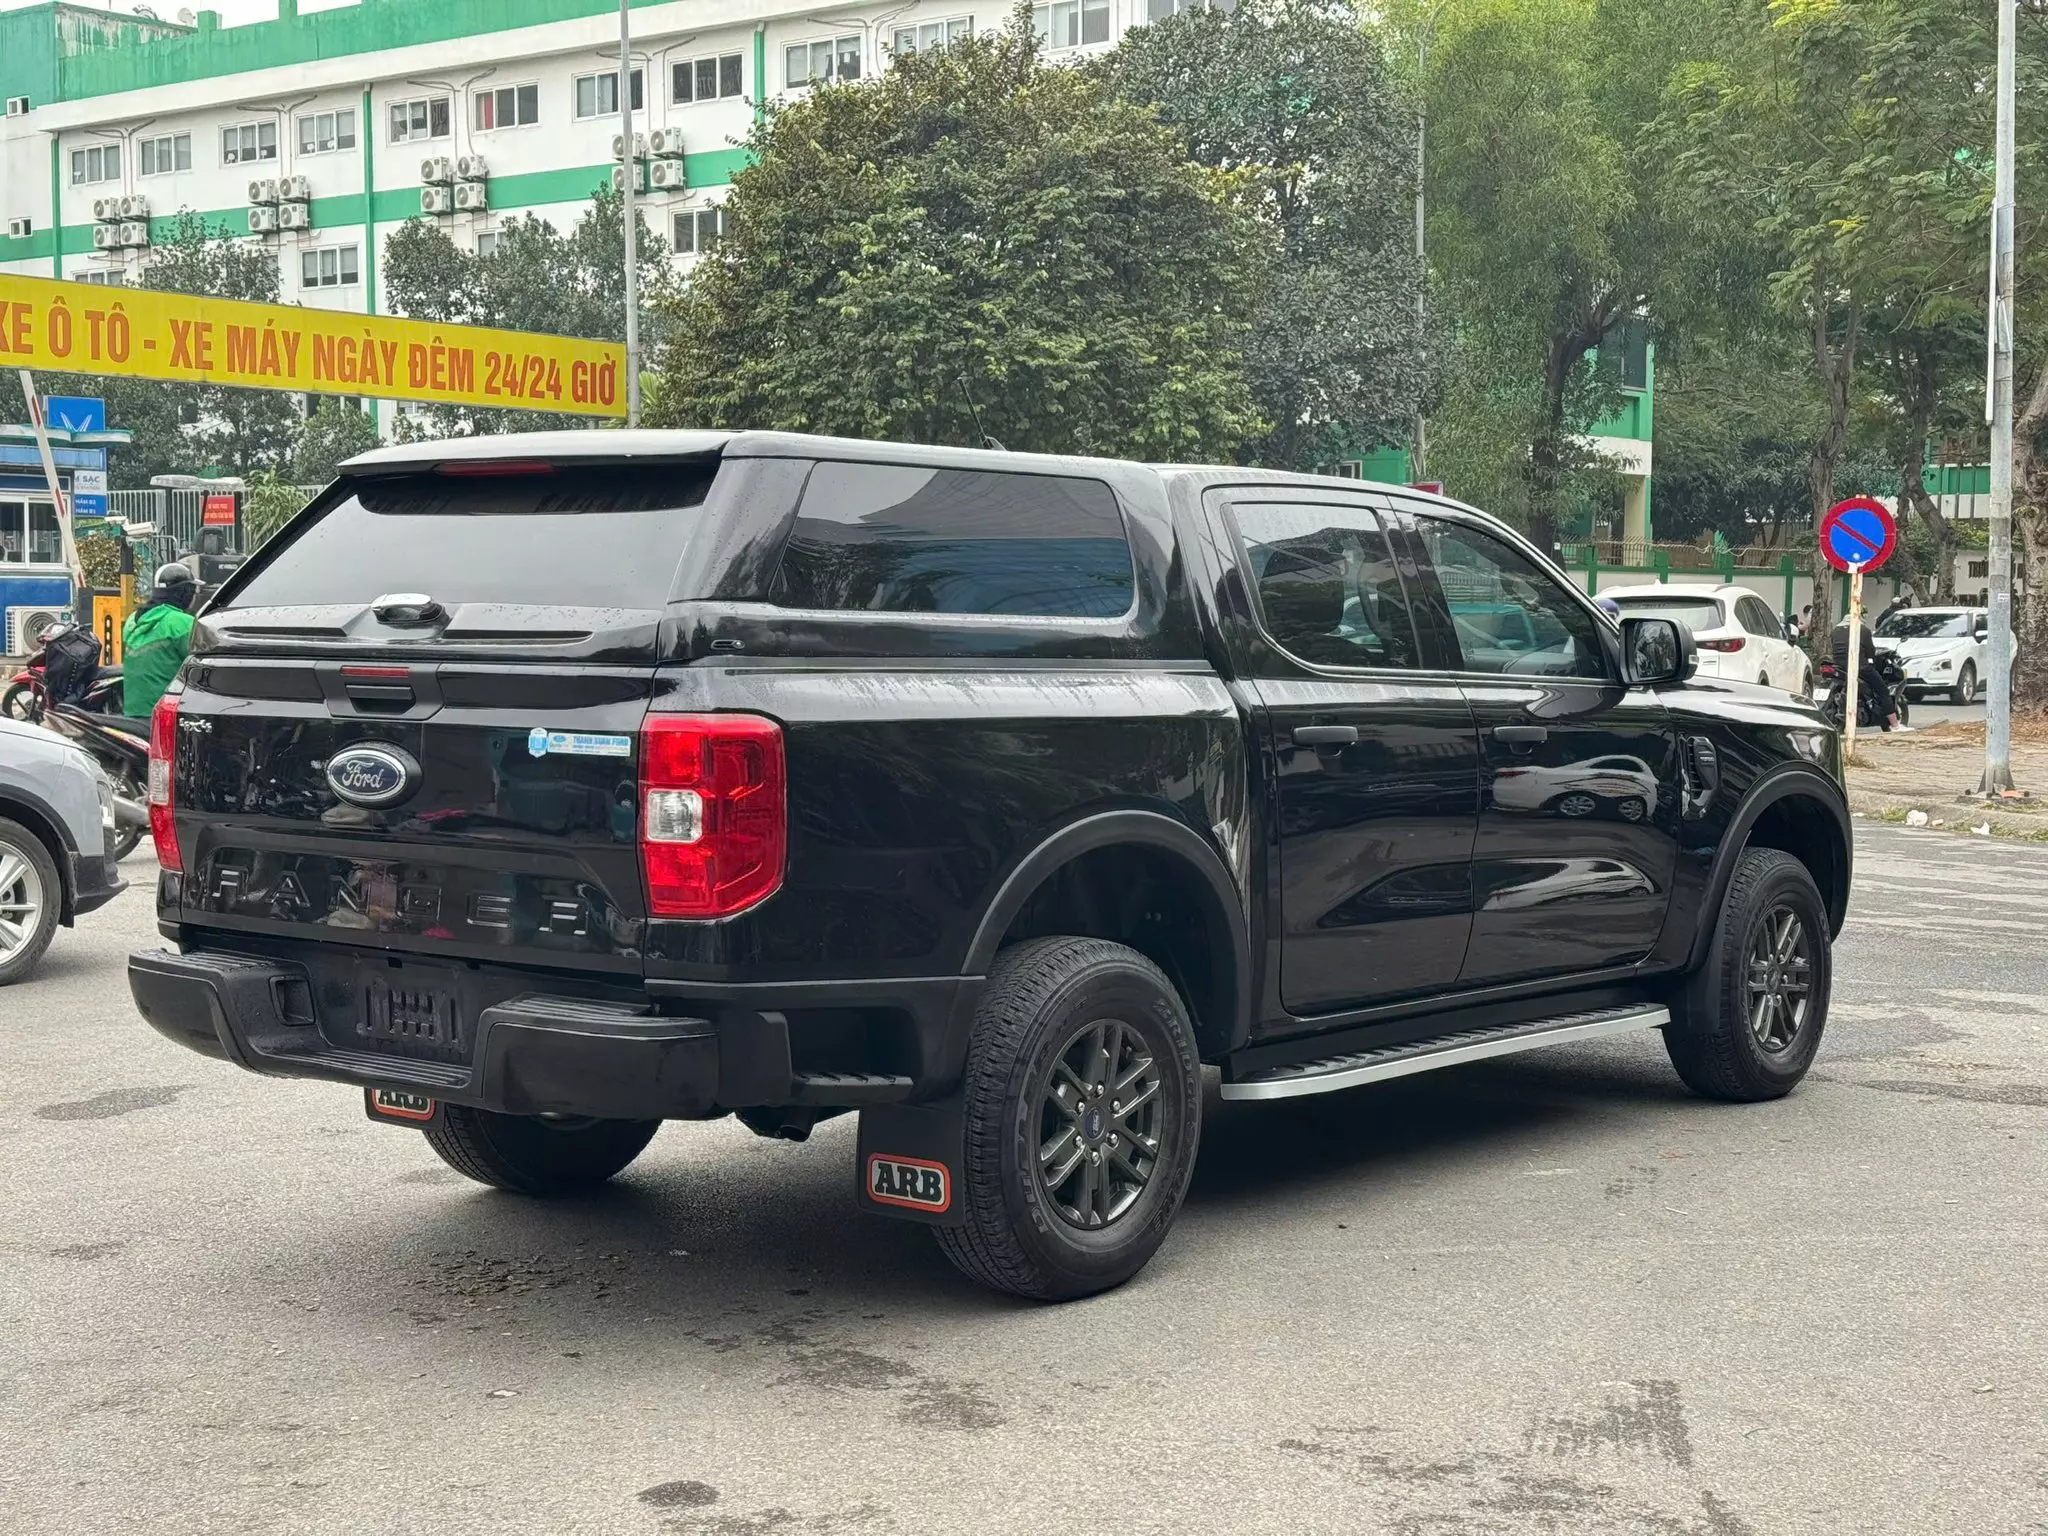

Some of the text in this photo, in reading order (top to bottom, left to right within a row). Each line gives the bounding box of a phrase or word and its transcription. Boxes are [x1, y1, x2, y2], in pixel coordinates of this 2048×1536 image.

[48, 295, 72, 358] Ô
[84, 301, 130, 364] TÔ
[168, 319, 214, 370] XE
[226, 318, 301, 378] MÁY
[312, 328, 398, 386] NGÀY
[408, 336, 475, 393] ĐÊM
[484, 351, 562, 401] 24/24
[571, 352, 617, 406] GIỜ
[341, 759, 385, 789] Ford
[210, 863, 591, 937] RANGER
[875, 1162, 942, 1203] ARB
